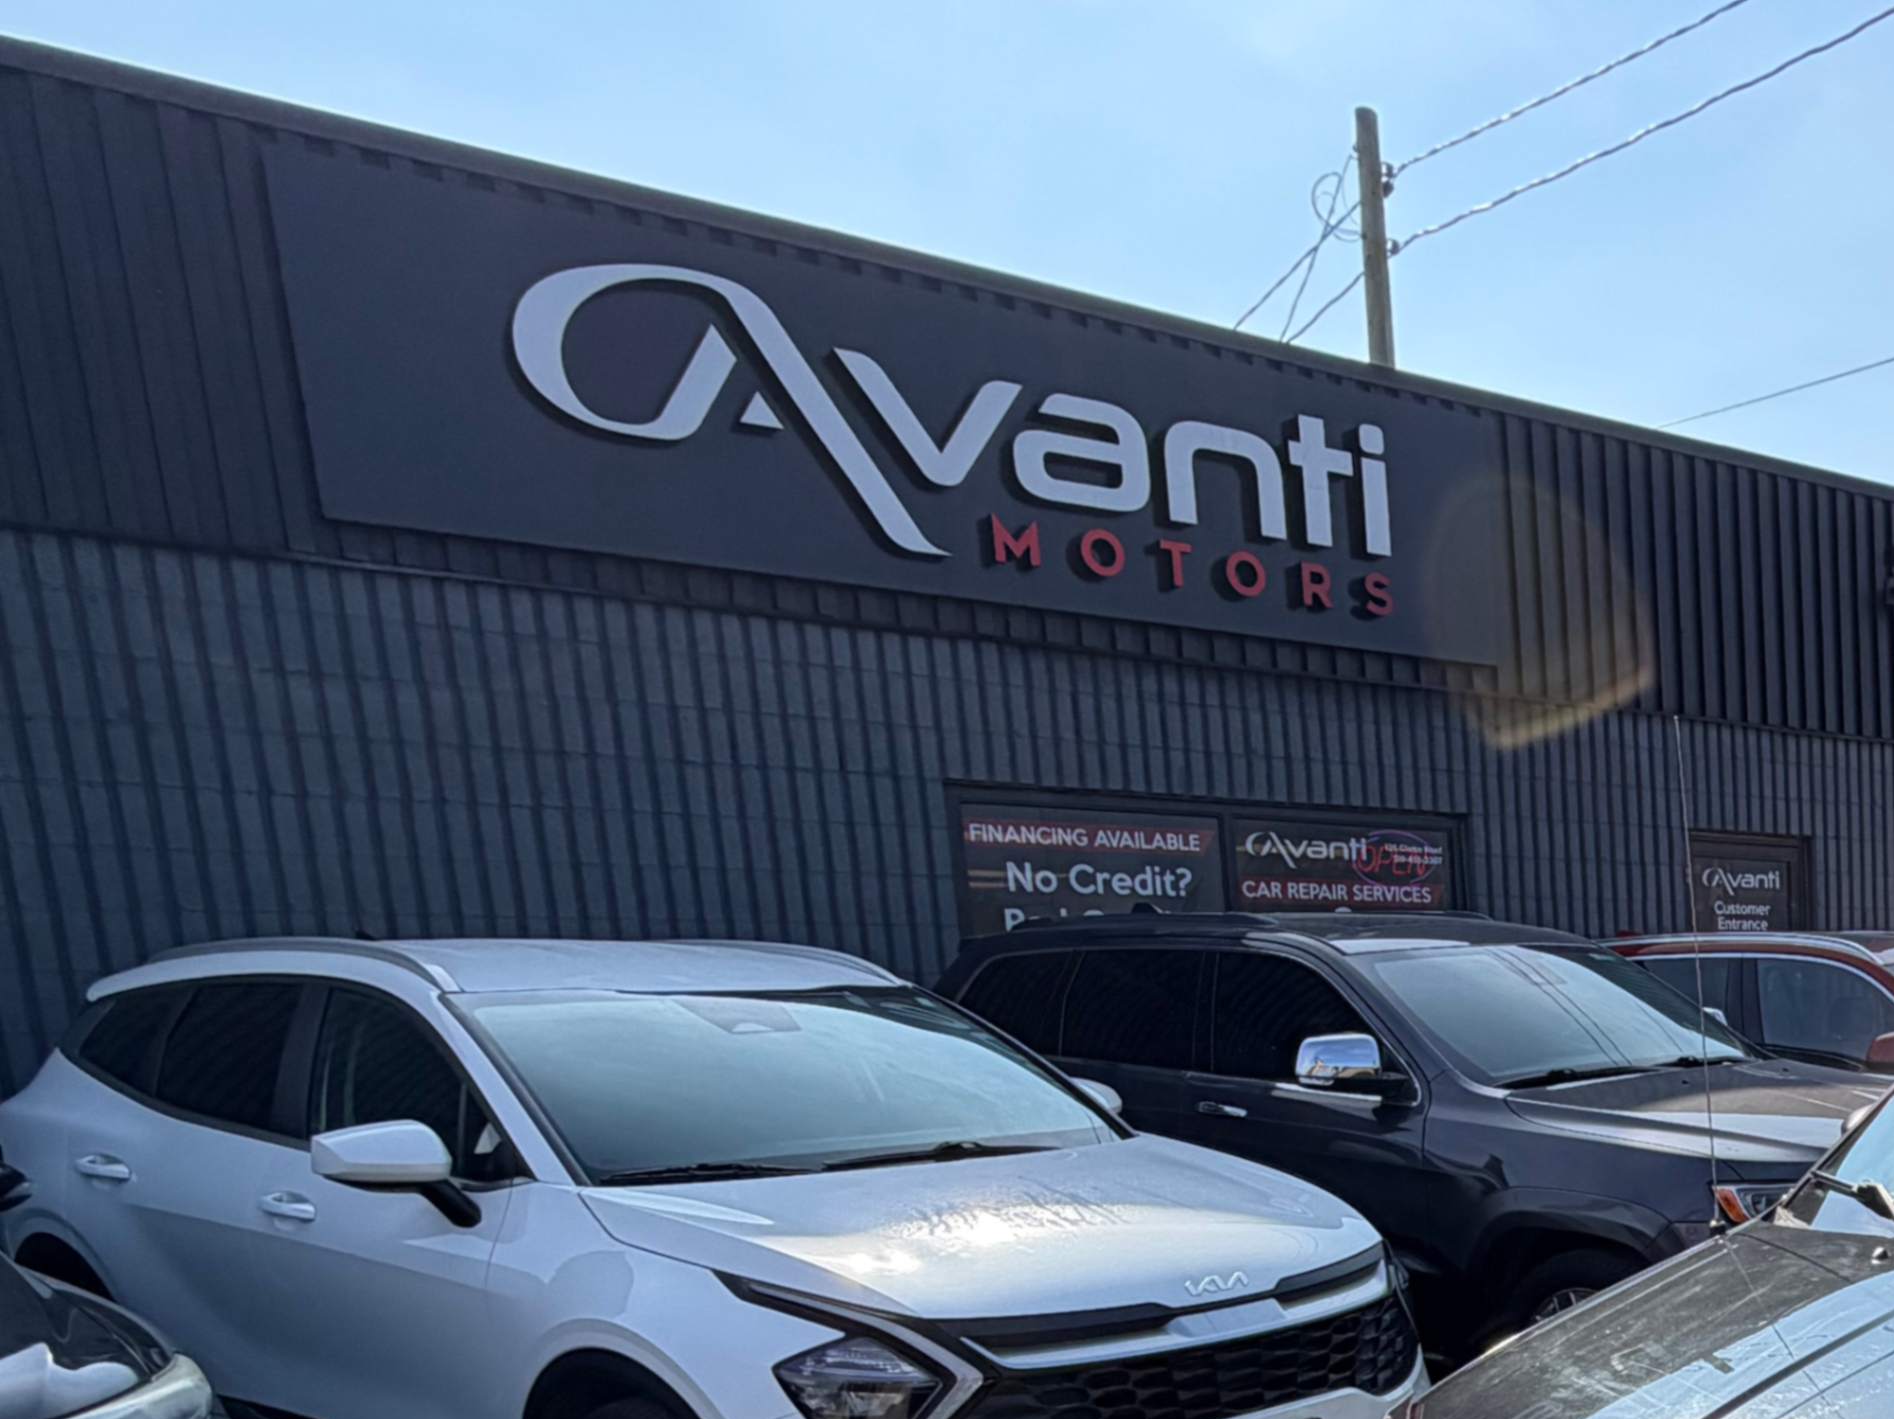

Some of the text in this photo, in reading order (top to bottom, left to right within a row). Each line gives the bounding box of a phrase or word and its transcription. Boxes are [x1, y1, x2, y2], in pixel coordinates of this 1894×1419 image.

[512, 263, 1392, 557] Avanti
[989, 513, 1394, 618] MOTORS
[968, 823, 1201, 852] FINANCING AVAILABLE
[1245, 831, 1368, 870] Avanti
[1006, 861, 1192, 897] No Credit?
[1242, 880, 1432, 904] CAR REPAIR SERVICES
[1702, 867, 1781, 896] Avanti
[1714, 901, 1771, 915] Customer
[1717, 916, 1769, 931] Entrance
